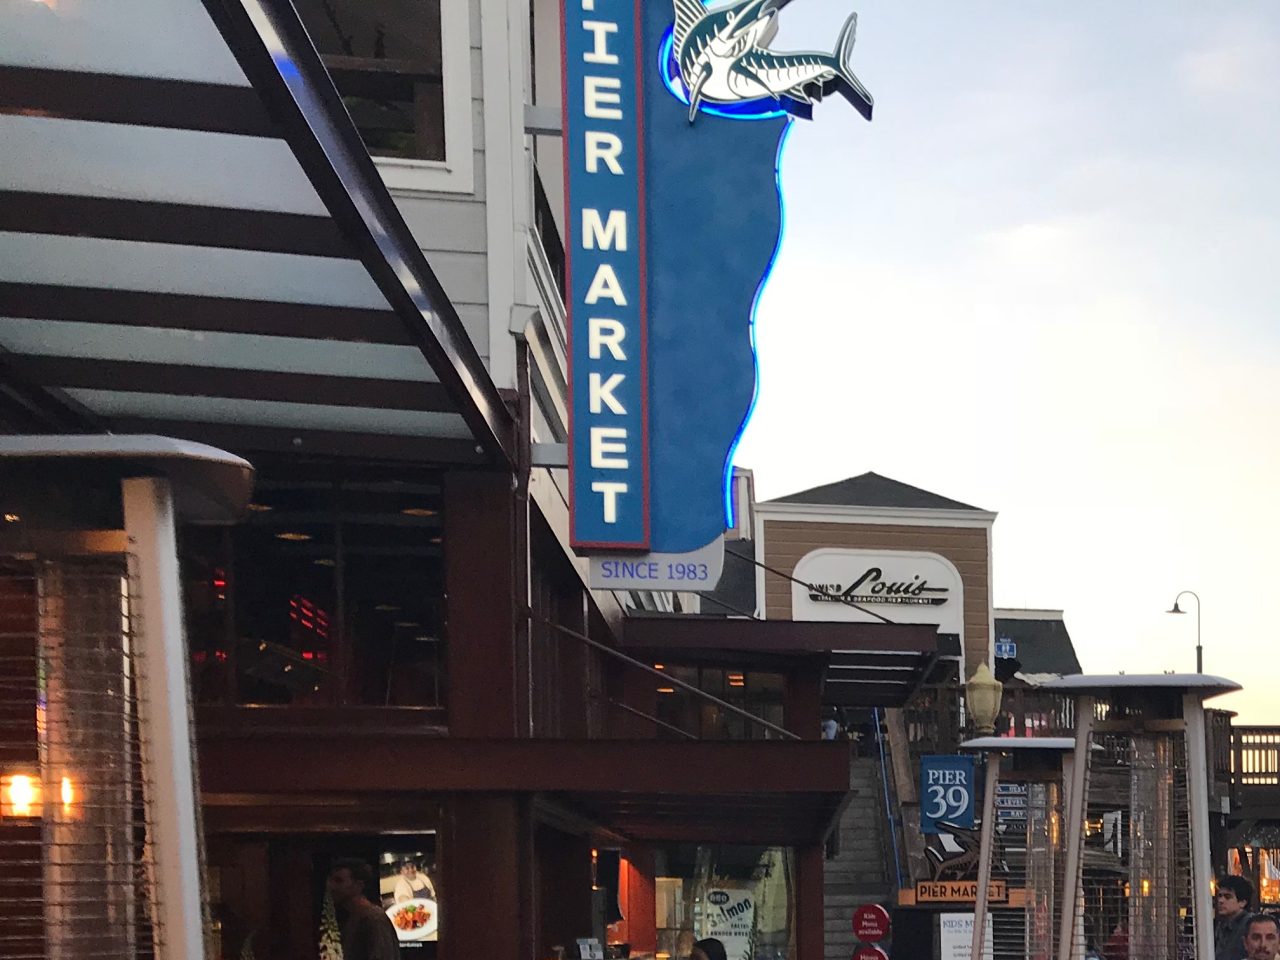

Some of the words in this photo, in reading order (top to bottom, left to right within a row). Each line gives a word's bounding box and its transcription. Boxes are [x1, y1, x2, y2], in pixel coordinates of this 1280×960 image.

[582, 0, 624, 175] IER
[581, 208, 629, 524] MARKET
[601, 561, 659, 579] SINCE
[667, 563, 708, 580] 1983
[843, 567, 949, 597] Louis
[928, 769, 967, 785] PIER
[926, 785, 969, 819] 39
[920, 885, 947, 897] PIER
[951, 885, 1003, 897] MARET
